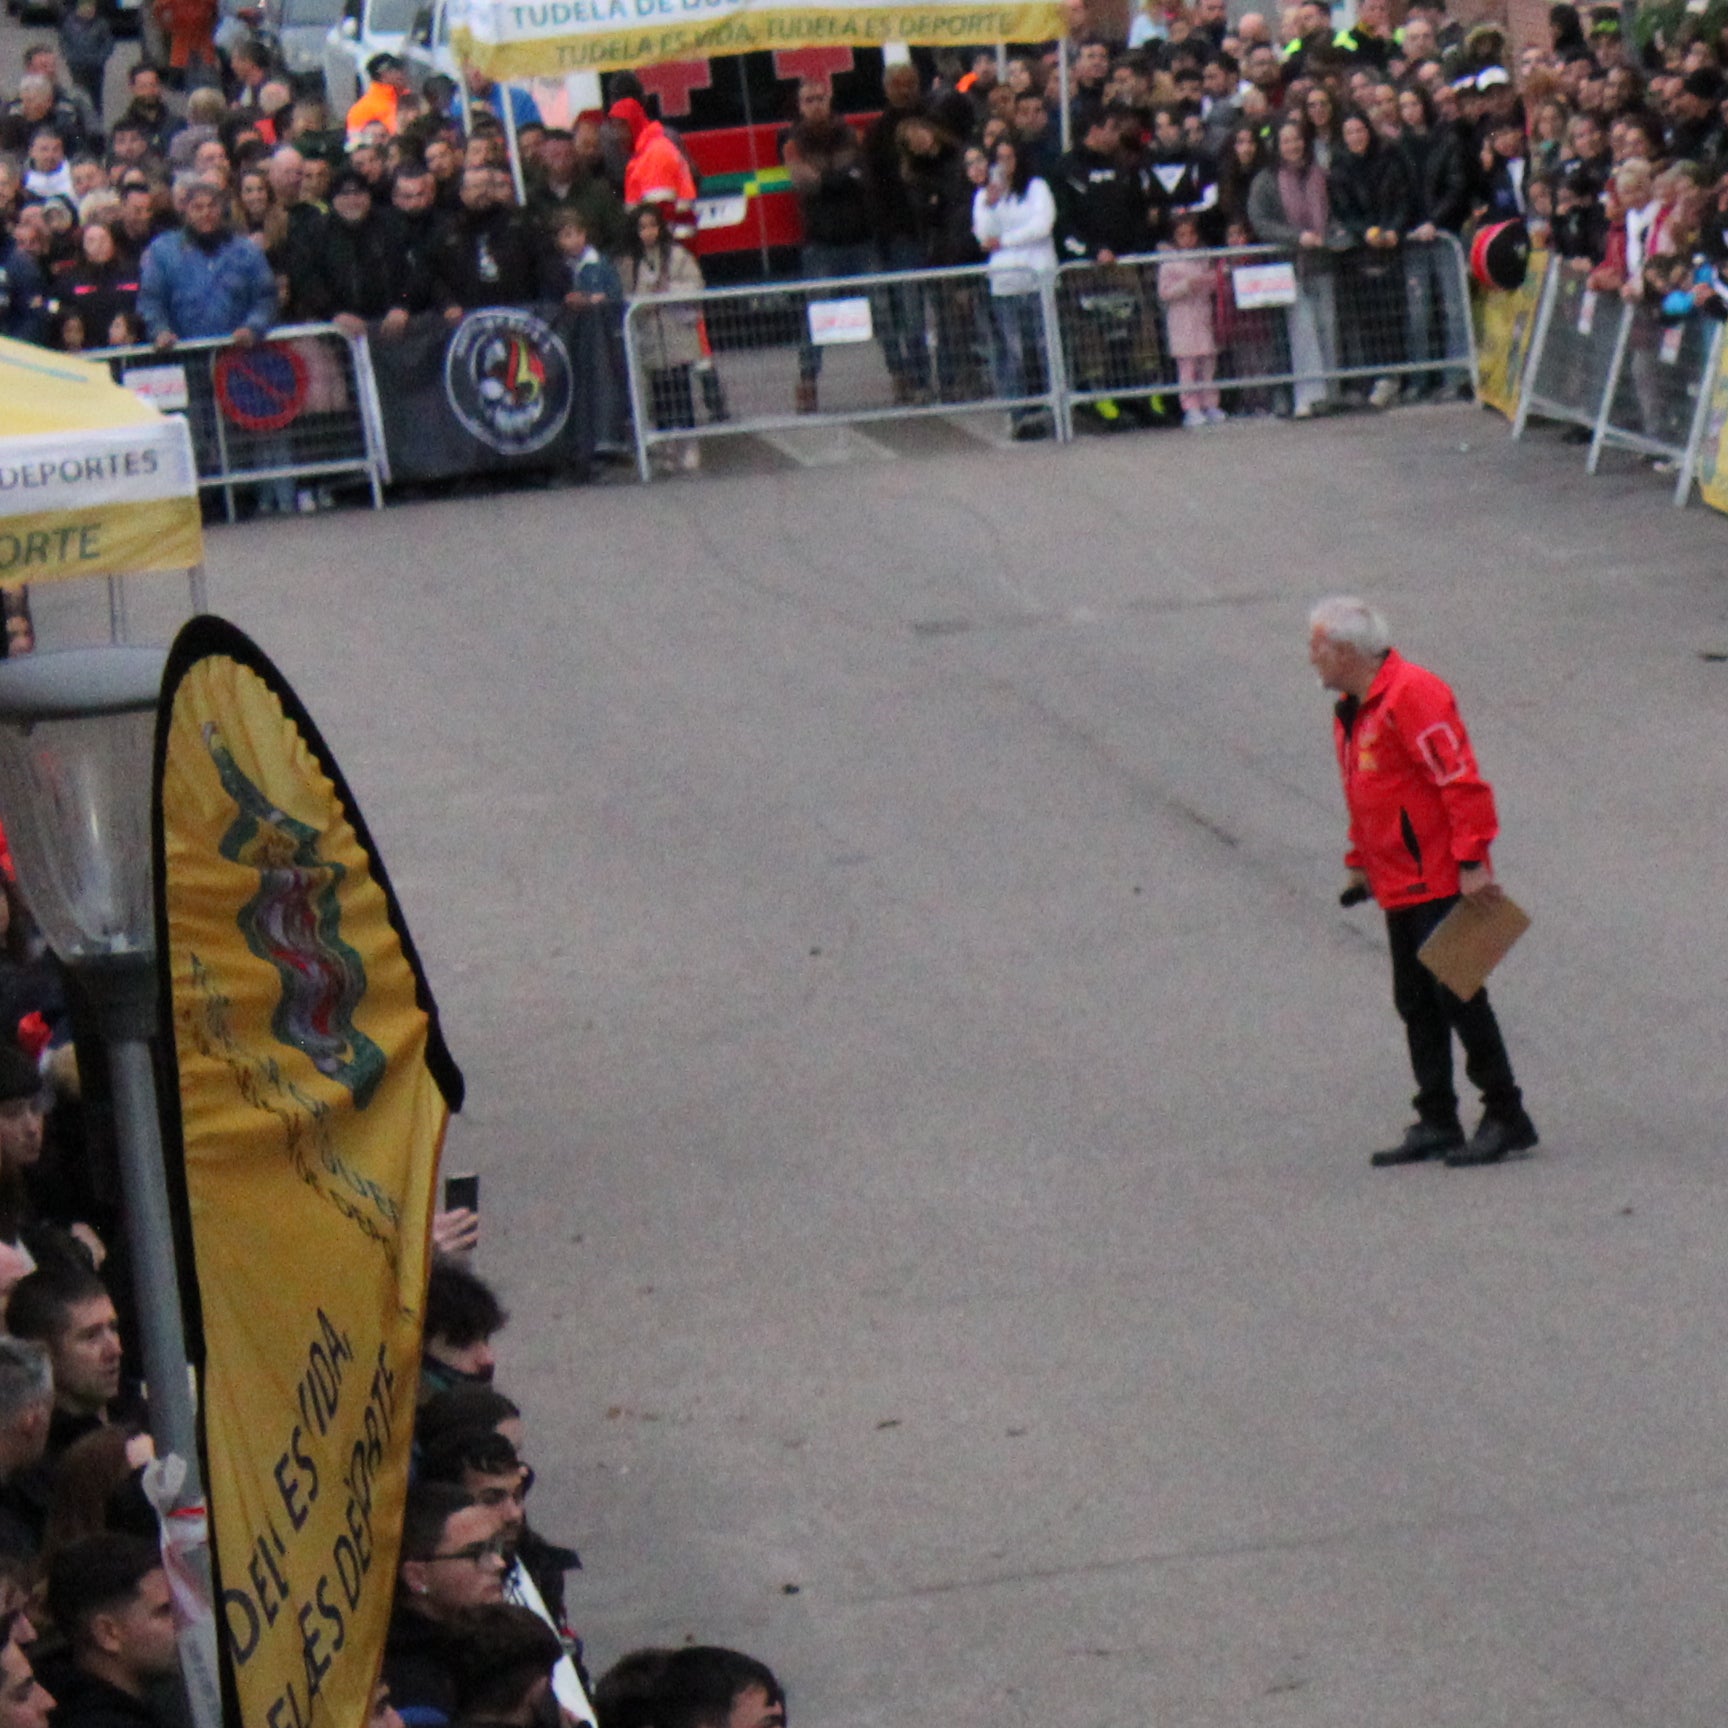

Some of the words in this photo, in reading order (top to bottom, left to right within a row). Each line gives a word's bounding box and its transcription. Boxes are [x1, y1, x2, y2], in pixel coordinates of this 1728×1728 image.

[512, 0, 627, 29] TUDELA
[555, 36, 656, 65] TUDELA
[767, 16, 858, 38] TUDELA
[900, 11, 1013, 36] DEPORTE
[273, 1425, 319, 1532] ES
